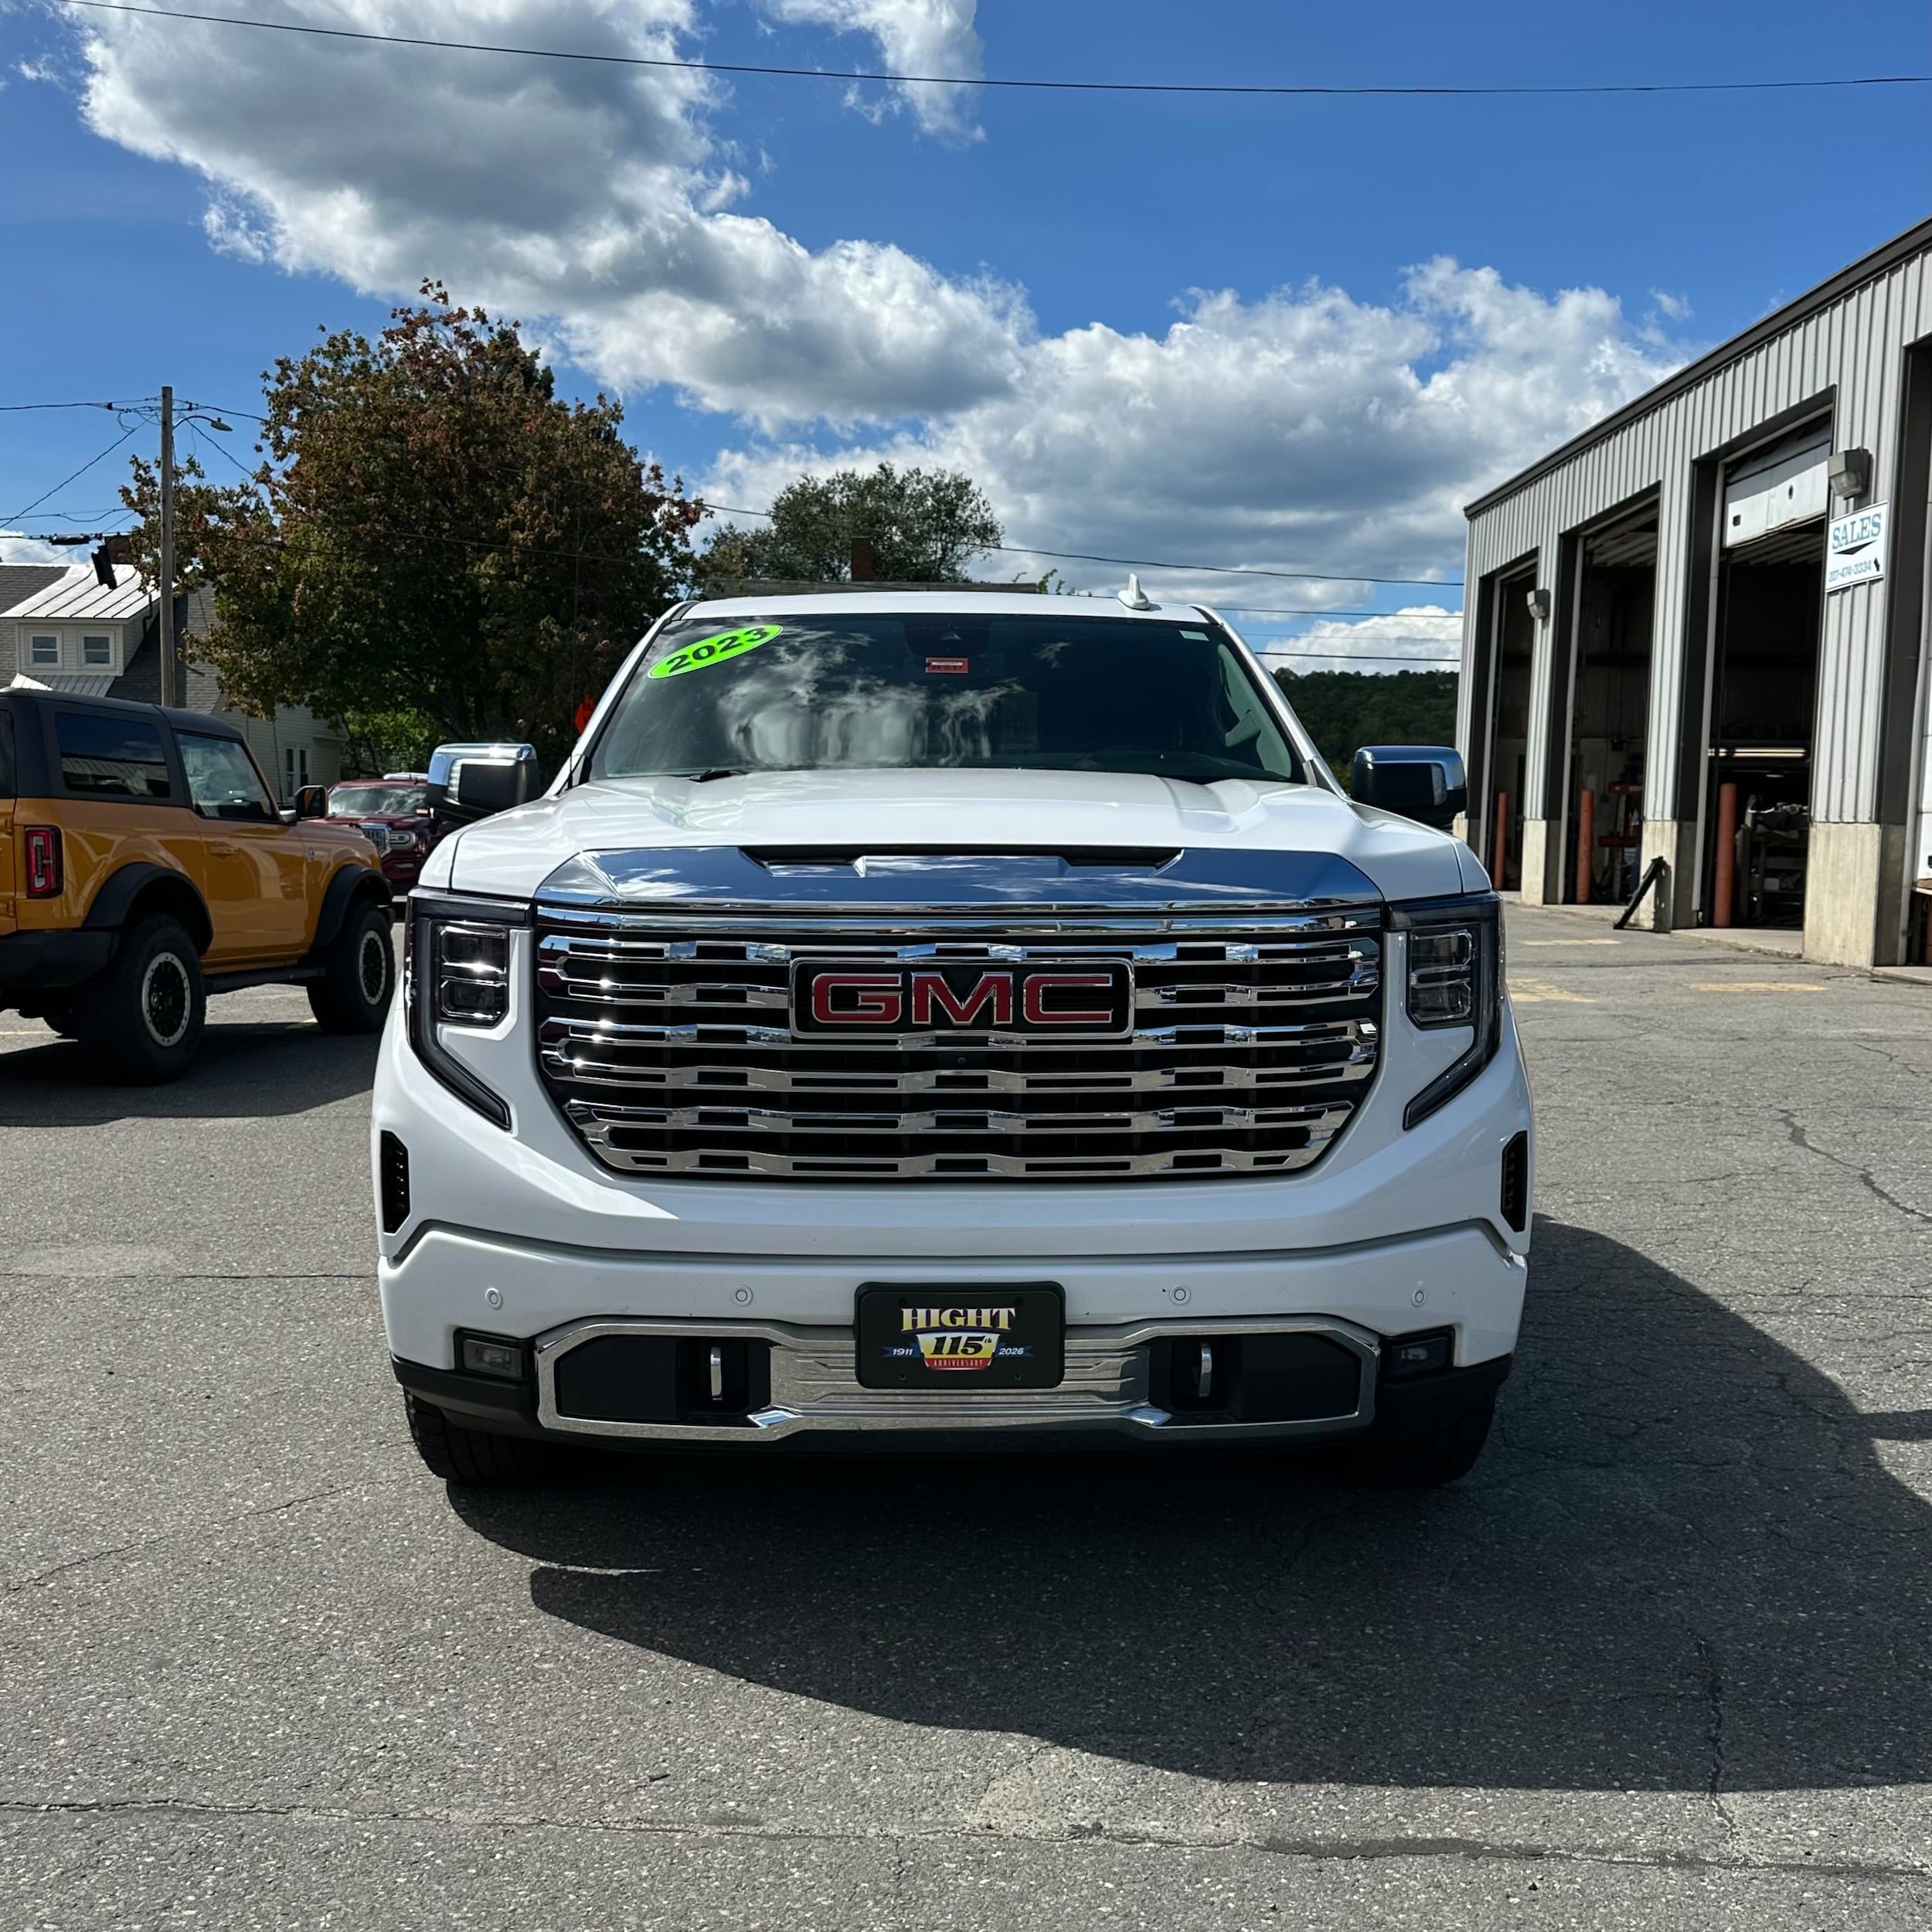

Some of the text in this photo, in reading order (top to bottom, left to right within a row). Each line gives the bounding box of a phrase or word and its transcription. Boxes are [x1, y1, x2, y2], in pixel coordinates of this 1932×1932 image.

[1832, 512, 1882, 549] SALES
[666, 628, 770, 673] 2023
[811, 971, 1113, 1026] GMC
[901, 1308, 1016, 1332] HIGHT
[934, 1359, 984, 1368] ANNIVERSARY
